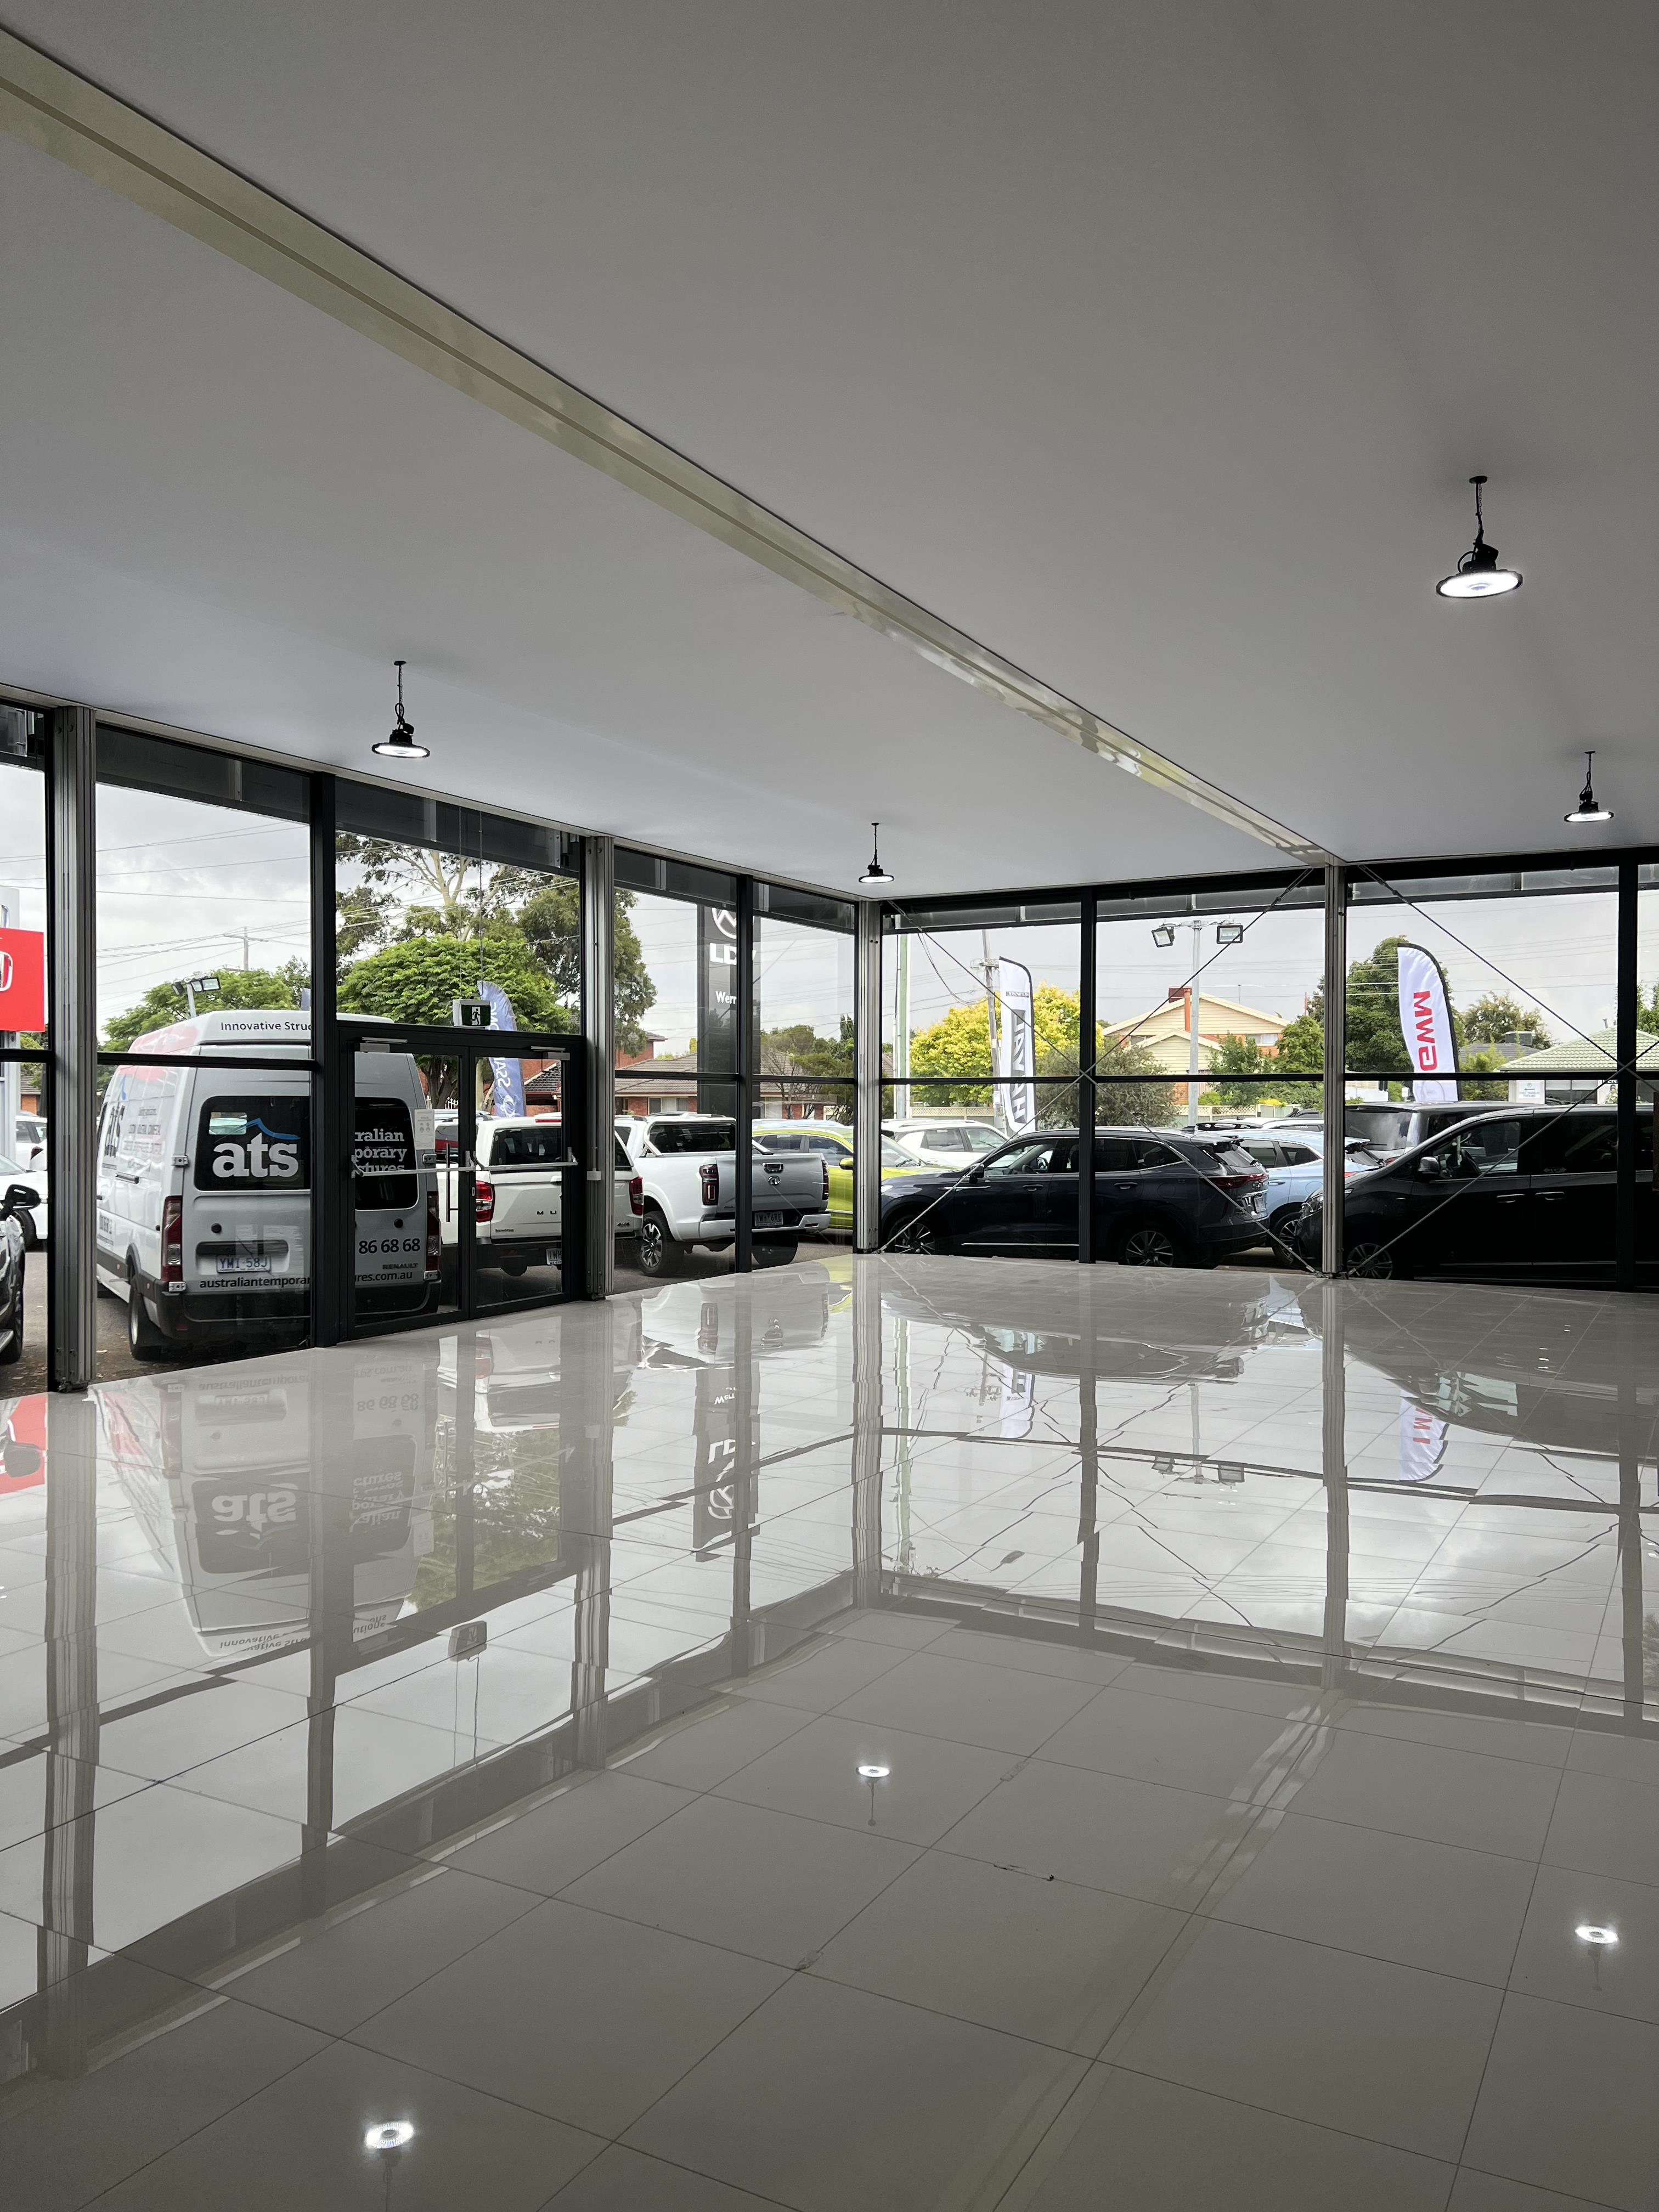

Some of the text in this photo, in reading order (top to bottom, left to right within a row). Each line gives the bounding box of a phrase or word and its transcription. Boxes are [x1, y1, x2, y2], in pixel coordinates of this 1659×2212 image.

[710, 943, 757, 966] LD
[221, 1021, 281, 1031] Innovative
[354, 1128, 405, 1142] ralian
[212, 1132, 299, 1178] ats
[358, 1238, 421, 1254] 86 68 68
